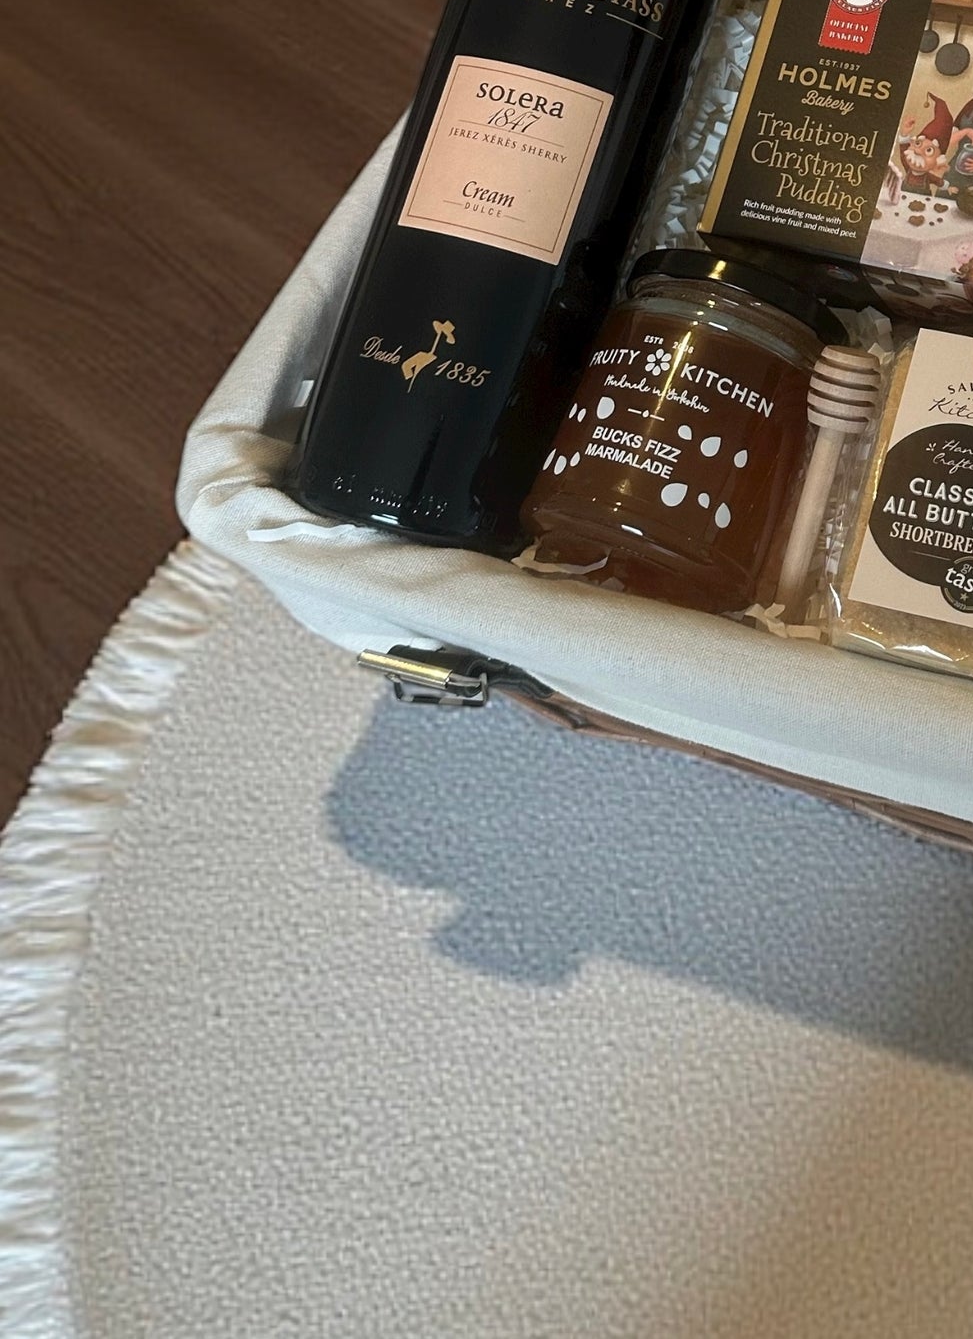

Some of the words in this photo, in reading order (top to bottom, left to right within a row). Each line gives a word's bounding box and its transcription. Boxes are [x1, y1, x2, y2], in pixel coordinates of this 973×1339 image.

[829, 31, 864, 43] BAKERY
[777, 62, 892, 100] HOLMES
[801, 90, 855, 116] Bakery
[487, 107, 542, 133] 1847
[757, 110, 880, 158] Traditional
[449, 127, 479, 140] JEREZ
[521, 143, 568, 164] SHERRY
[751, 140, 869, 187] Christmas
[462, 180, 516, 208] Cream
[464, 202, 503, 218] DULCE
[775, 172, 868, 223] Pudding
[740, 209, 771, 221] delicious
[771, 216, 787, 225] vine
[787, 218, 803, 228] fruit
[803, 222, 818, 231] and
[818, 225, 840, 235] mixed
[743, 199, 760, 209] Rich
[760, 202, 775, 212] fruit
[775, 207, 804, 219] pudding
[804, 212, 825, 223] made
[825, 216, 842, 225] with
[360, 336, 402, 364] Desde
[434, 359, 491, 387] 1835
[589, 348, 641, 368] FRUITY
[680, 362, 774, 418] KITCHEN
[652, 386, 664, 397] in
[666, 386, 710, 413] Yorkshire
[592, 425, 643, 449] BUCKS
[644, 439, 682, 463] FIZZ
[584, 443, 674, 480] MARMALADE
[883, 495, 918, 519] ALL
